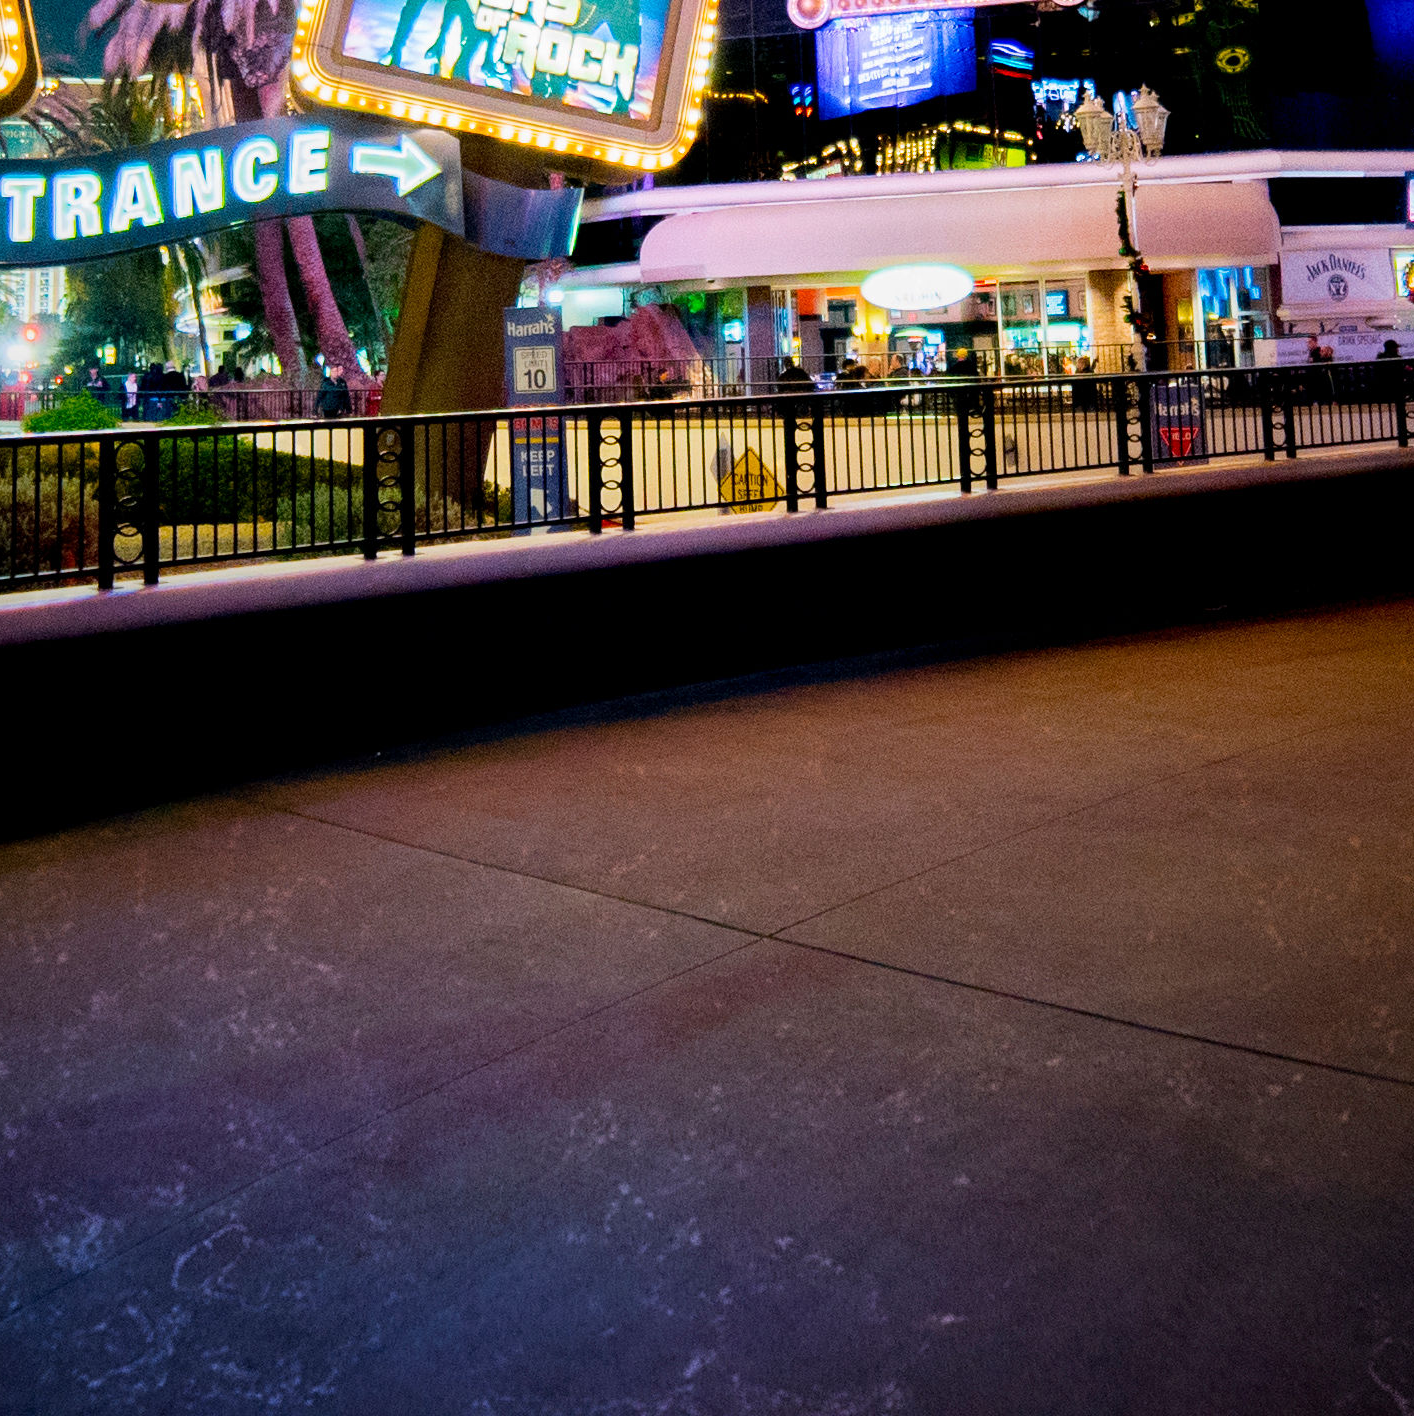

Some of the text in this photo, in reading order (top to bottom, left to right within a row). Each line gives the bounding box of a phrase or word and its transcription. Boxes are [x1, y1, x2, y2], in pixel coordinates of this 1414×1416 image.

[475, 4, 513, 36] OF
[502, 18, 638, 102] ROCK
[1305, 253, 1367, 283] JACK DANIEL'S
[520, 350, 548, 360] SPEED
[523, 368, 547, 389] 10
[520, 449, 556, 463] KEEP
[522, 464, 555, 477] LEFT
[734, 473, 769, 487] CATION
